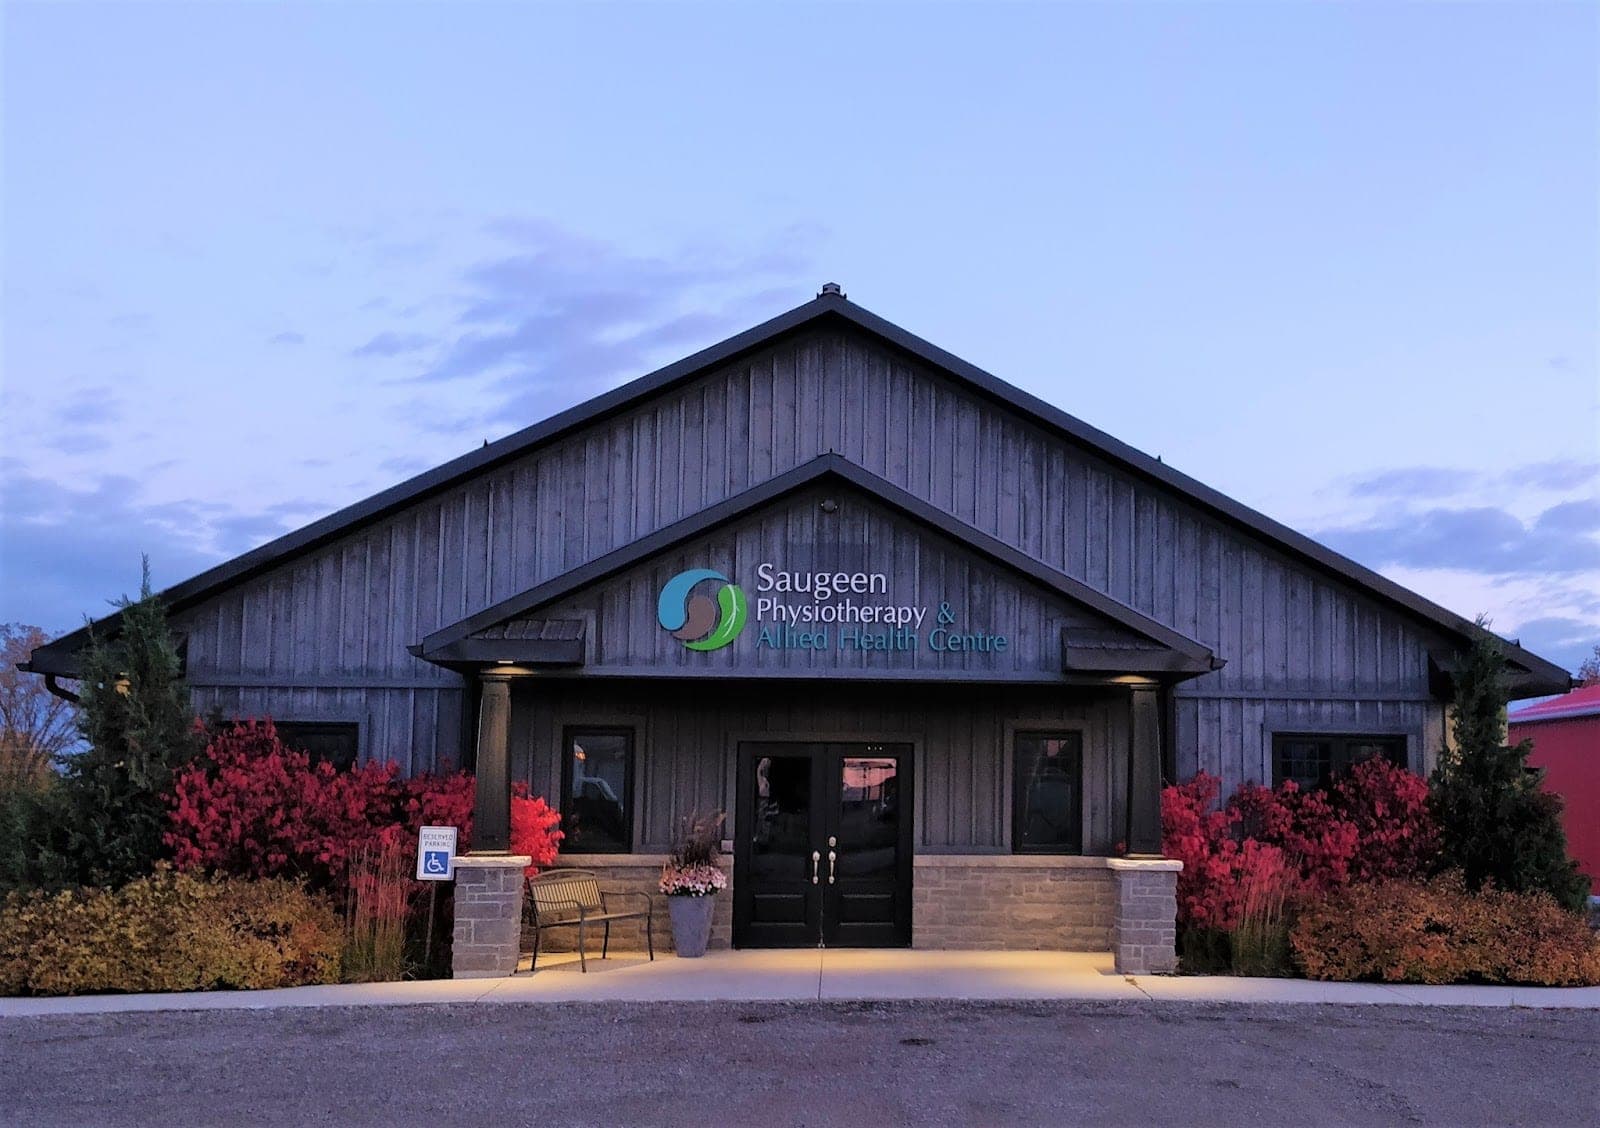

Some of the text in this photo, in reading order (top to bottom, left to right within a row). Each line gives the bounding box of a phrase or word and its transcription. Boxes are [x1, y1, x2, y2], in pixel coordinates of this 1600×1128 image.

[757, 563, 887, 600] Saugeen
[757, 597, 955, 629] Physiotherapy &
[756, 624, 1008, 652] Allied Health Centre
